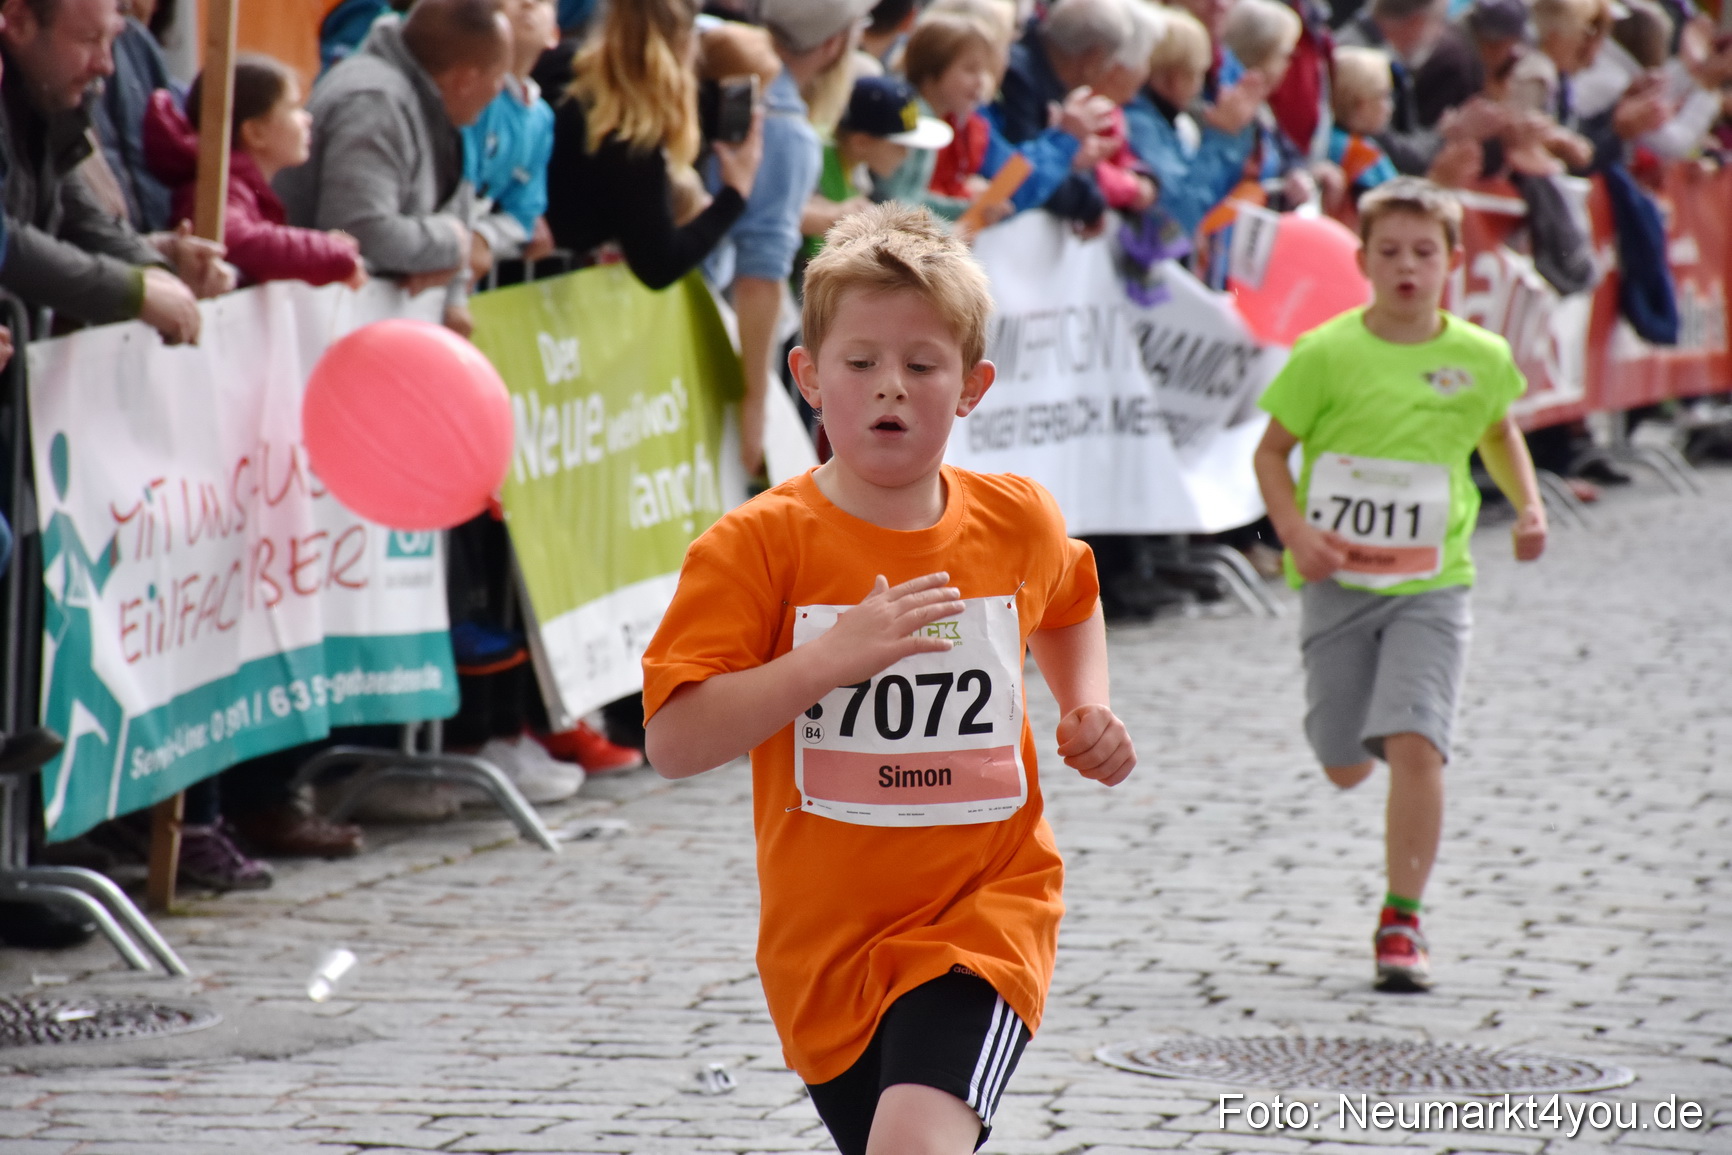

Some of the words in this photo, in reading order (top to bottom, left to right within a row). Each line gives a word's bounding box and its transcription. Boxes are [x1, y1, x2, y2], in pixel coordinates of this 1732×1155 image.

[511, 388, 605, 486] Neue
[1331, 496, 1421, 538] 7011
[837, 669, 994, 740] 7072
[805, 726, 821, 739] B4
[878, 765, 952, 788] Simon
